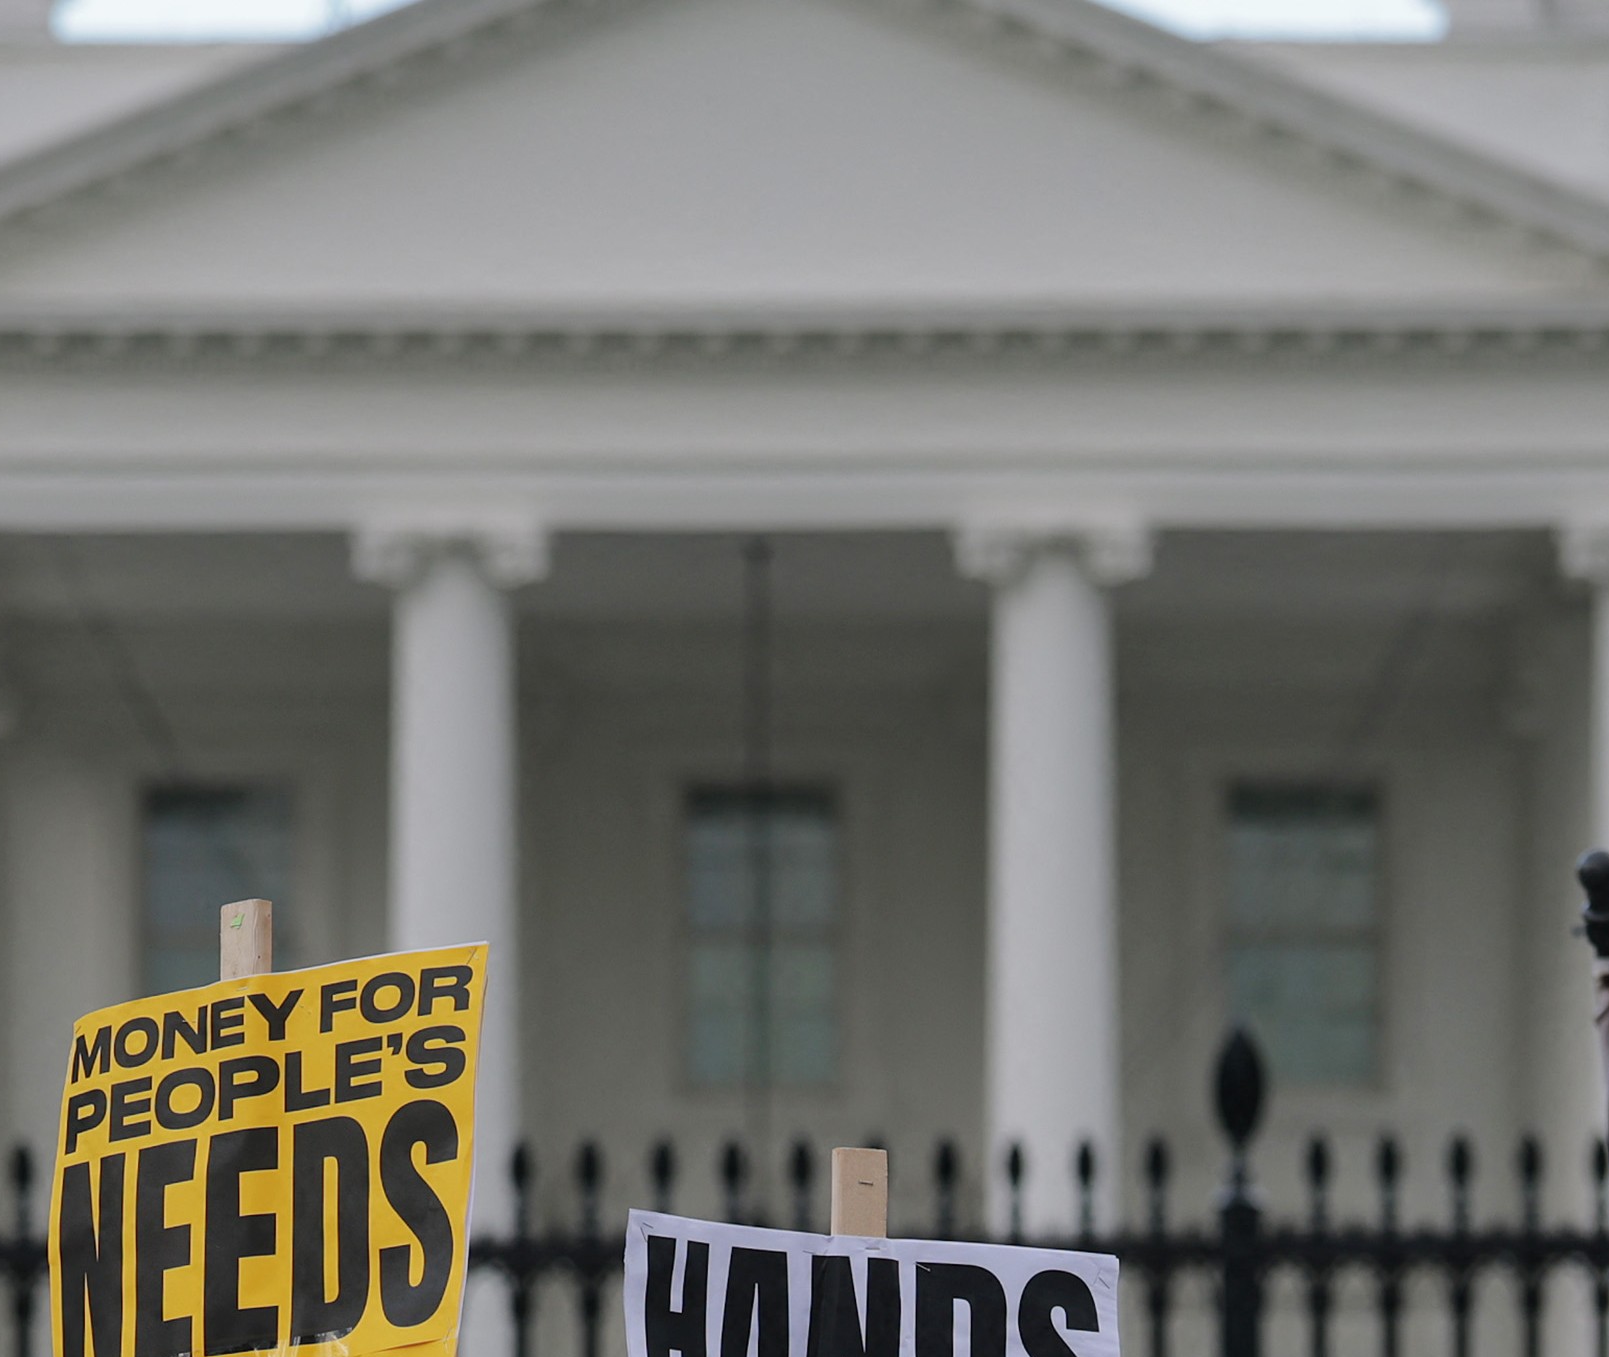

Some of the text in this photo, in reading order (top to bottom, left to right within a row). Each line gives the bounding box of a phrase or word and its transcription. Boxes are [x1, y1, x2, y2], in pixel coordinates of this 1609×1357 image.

[71, 964, 474, 1085] MONEY FOR
[65, 1024, 468, 1155] PEOPLE'S
